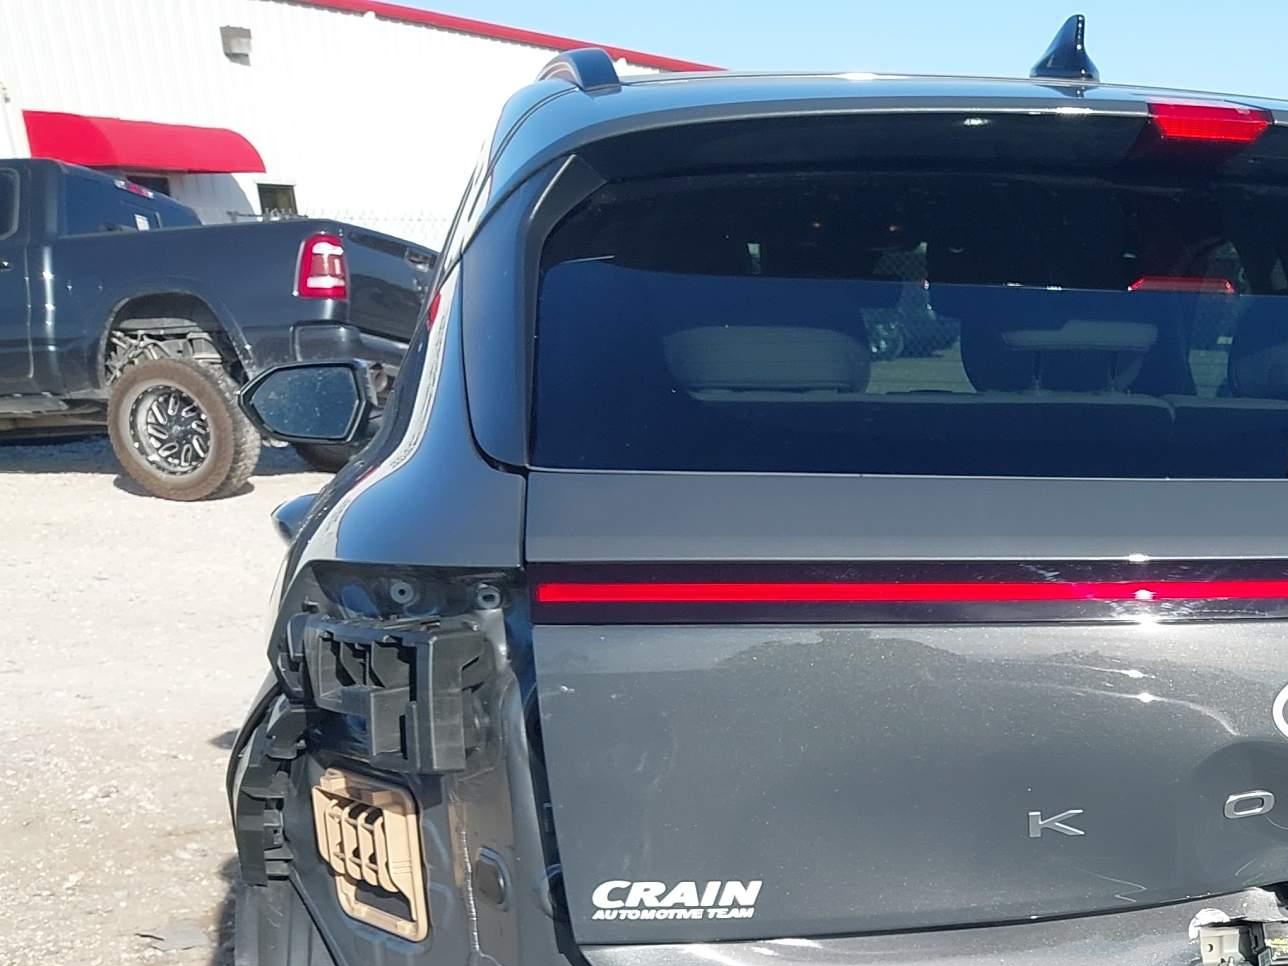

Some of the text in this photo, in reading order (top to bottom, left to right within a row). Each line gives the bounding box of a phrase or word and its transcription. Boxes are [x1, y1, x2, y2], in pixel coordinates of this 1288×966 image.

[592, 880, 763, 908] CRAIN
[592, 907, 755, 920] AUTOMOTIVE TEAM
